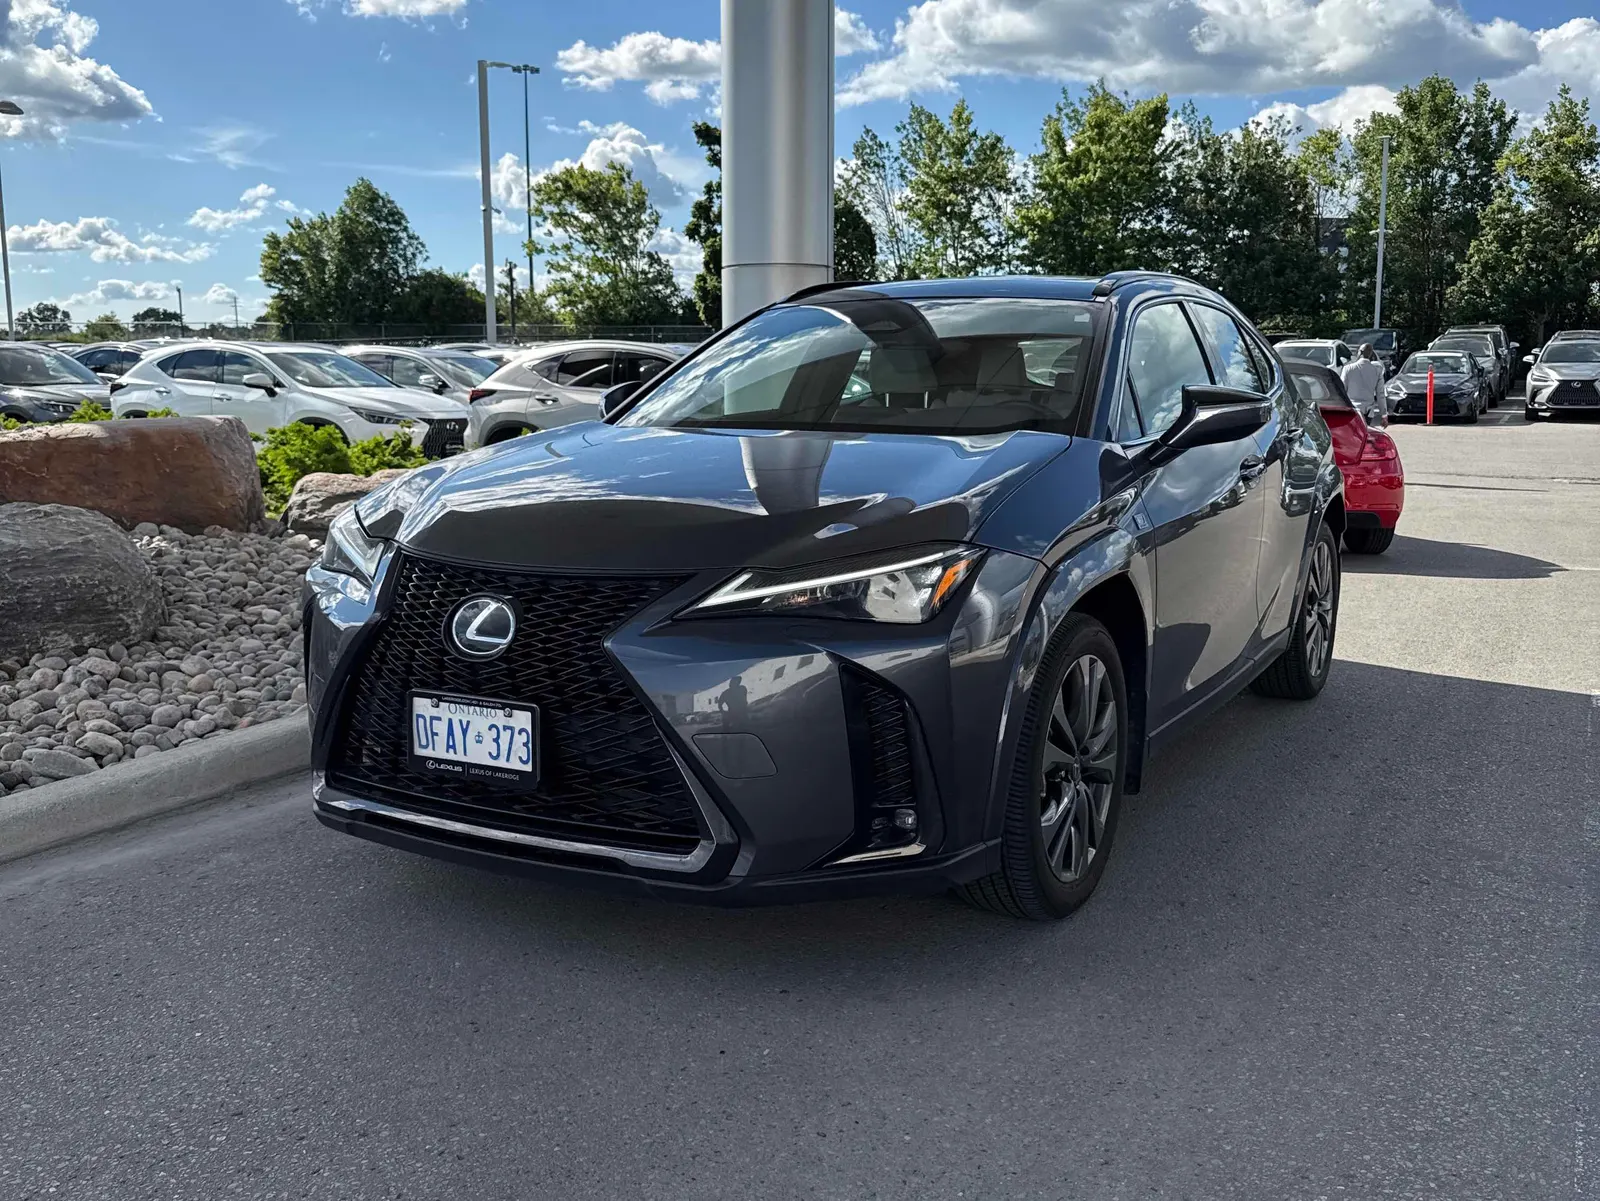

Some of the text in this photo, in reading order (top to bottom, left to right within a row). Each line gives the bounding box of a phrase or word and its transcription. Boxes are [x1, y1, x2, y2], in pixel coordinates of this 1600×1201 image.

[448, 703, 498, 719] ONTARIO
[415, 713, 531, 765] DFAY 373
[435, 763, 463, 772] LEXUS
[469, 767, 485, 776] LEXUS
[492, 772, 520, 781] LAKERIDGE
